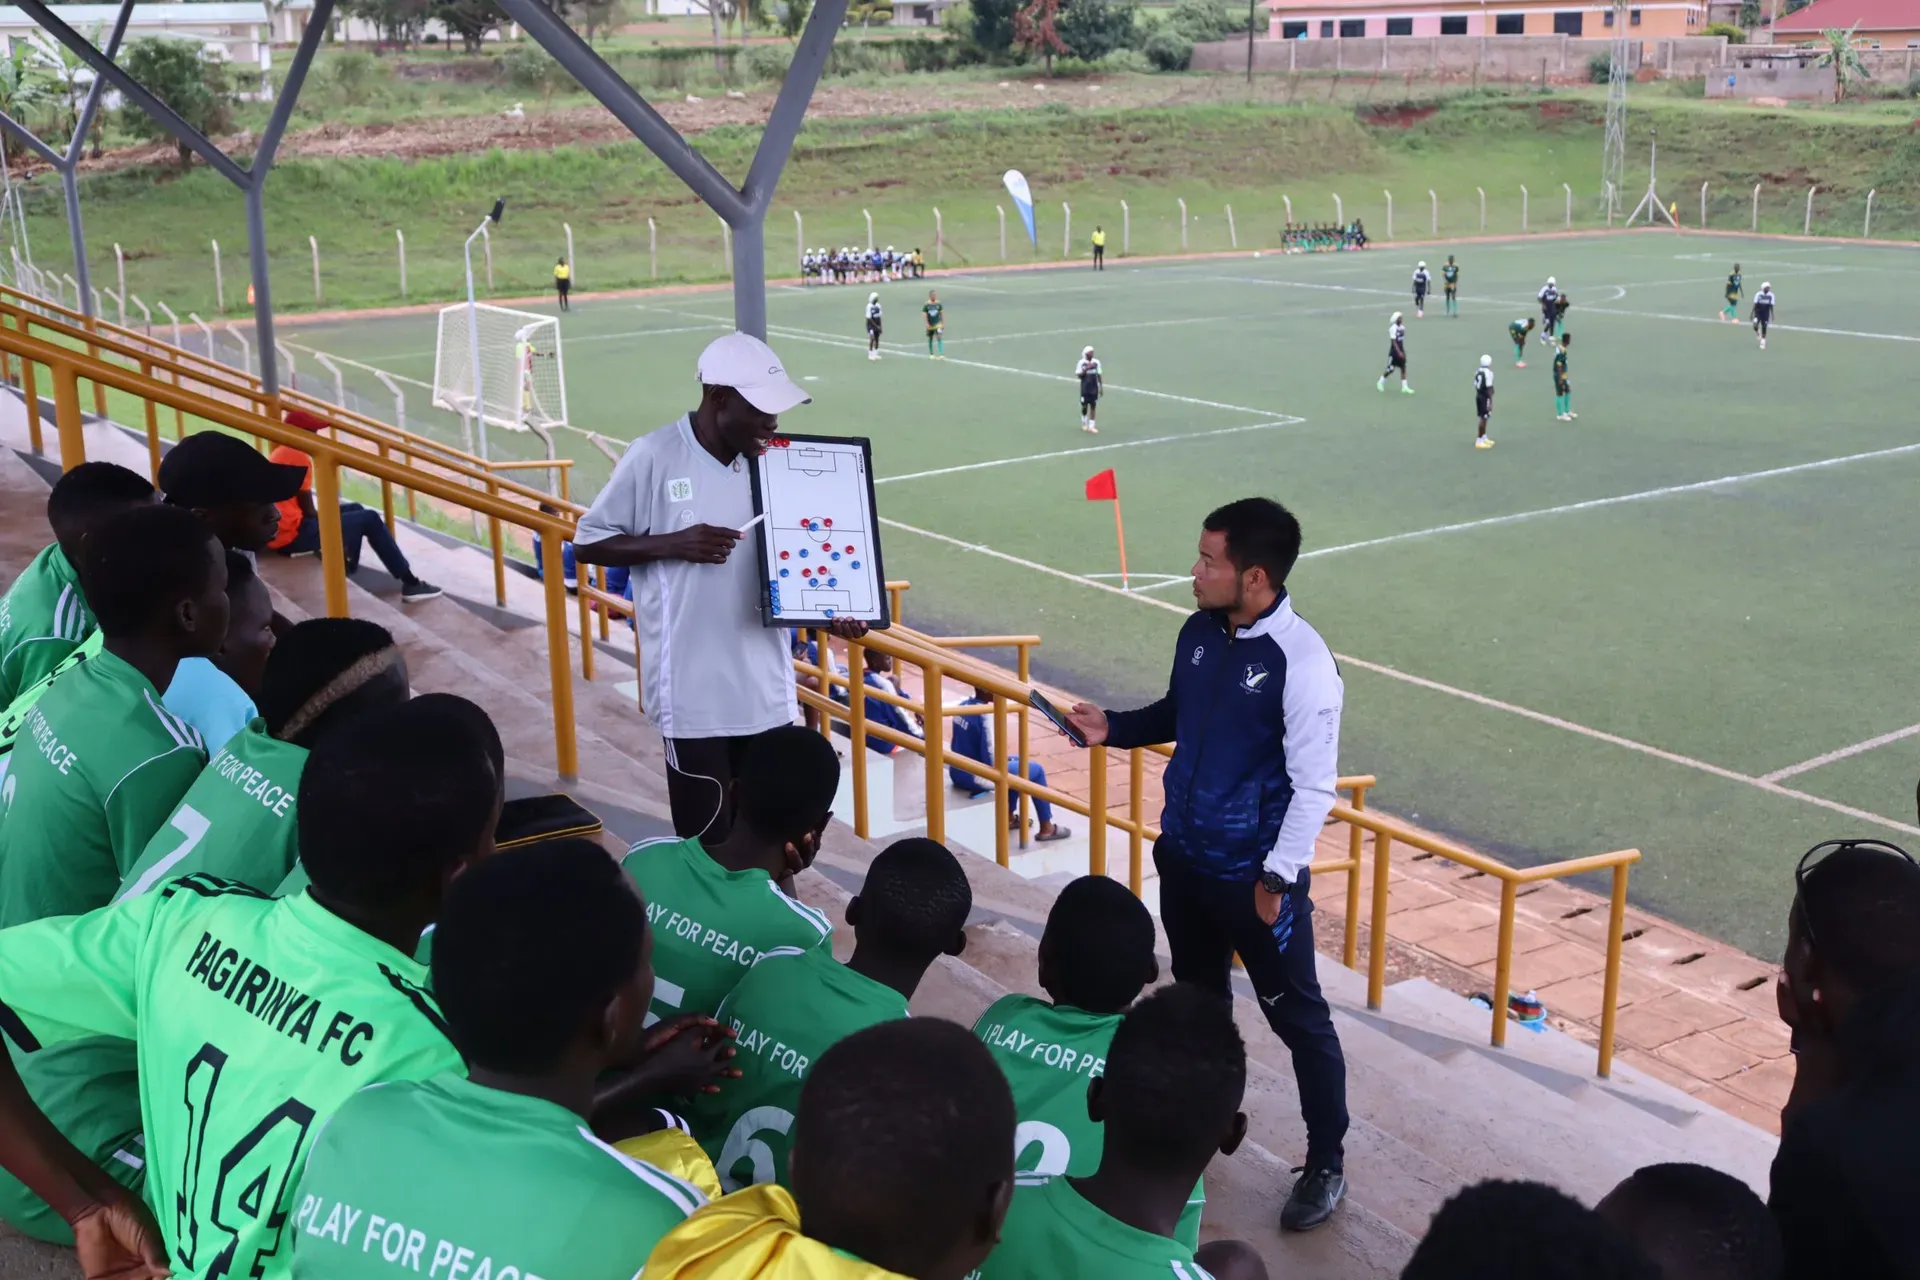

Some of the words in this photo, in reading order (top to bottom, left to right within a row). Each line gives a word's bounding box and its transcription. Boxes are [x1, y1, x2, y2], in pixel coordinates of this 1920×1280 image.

[29, 711, 47, 741] FOR
[36, 726, 78, 777] PEACE
[216, 753, 245, 783] FOR
[234, 765, 295, 818] PEACE
[112, 803, 211, 903] 7
[645, 901, 668, 925] AY
[665, 911, 702, 943] FOR
[185, 930, 322, 1045] PAGIRINYA
[316, 1010, 374, 1067] FC
[732, 1018, 771, 1056] PLAY
[769, 1042, 809, 1079] FOR
[986, 1024, 1034, 1053] PLAY
[1030, 1042, 1077, 1072] FOR
[176, 1041, 317, 1280] 14
[714, 1105, 796, 1196] 6
[297, 1193, 362, 1246] PLAY
[362, 1213, 427, 1273] FOR
[428, 1239, 547, 1280] PEA
